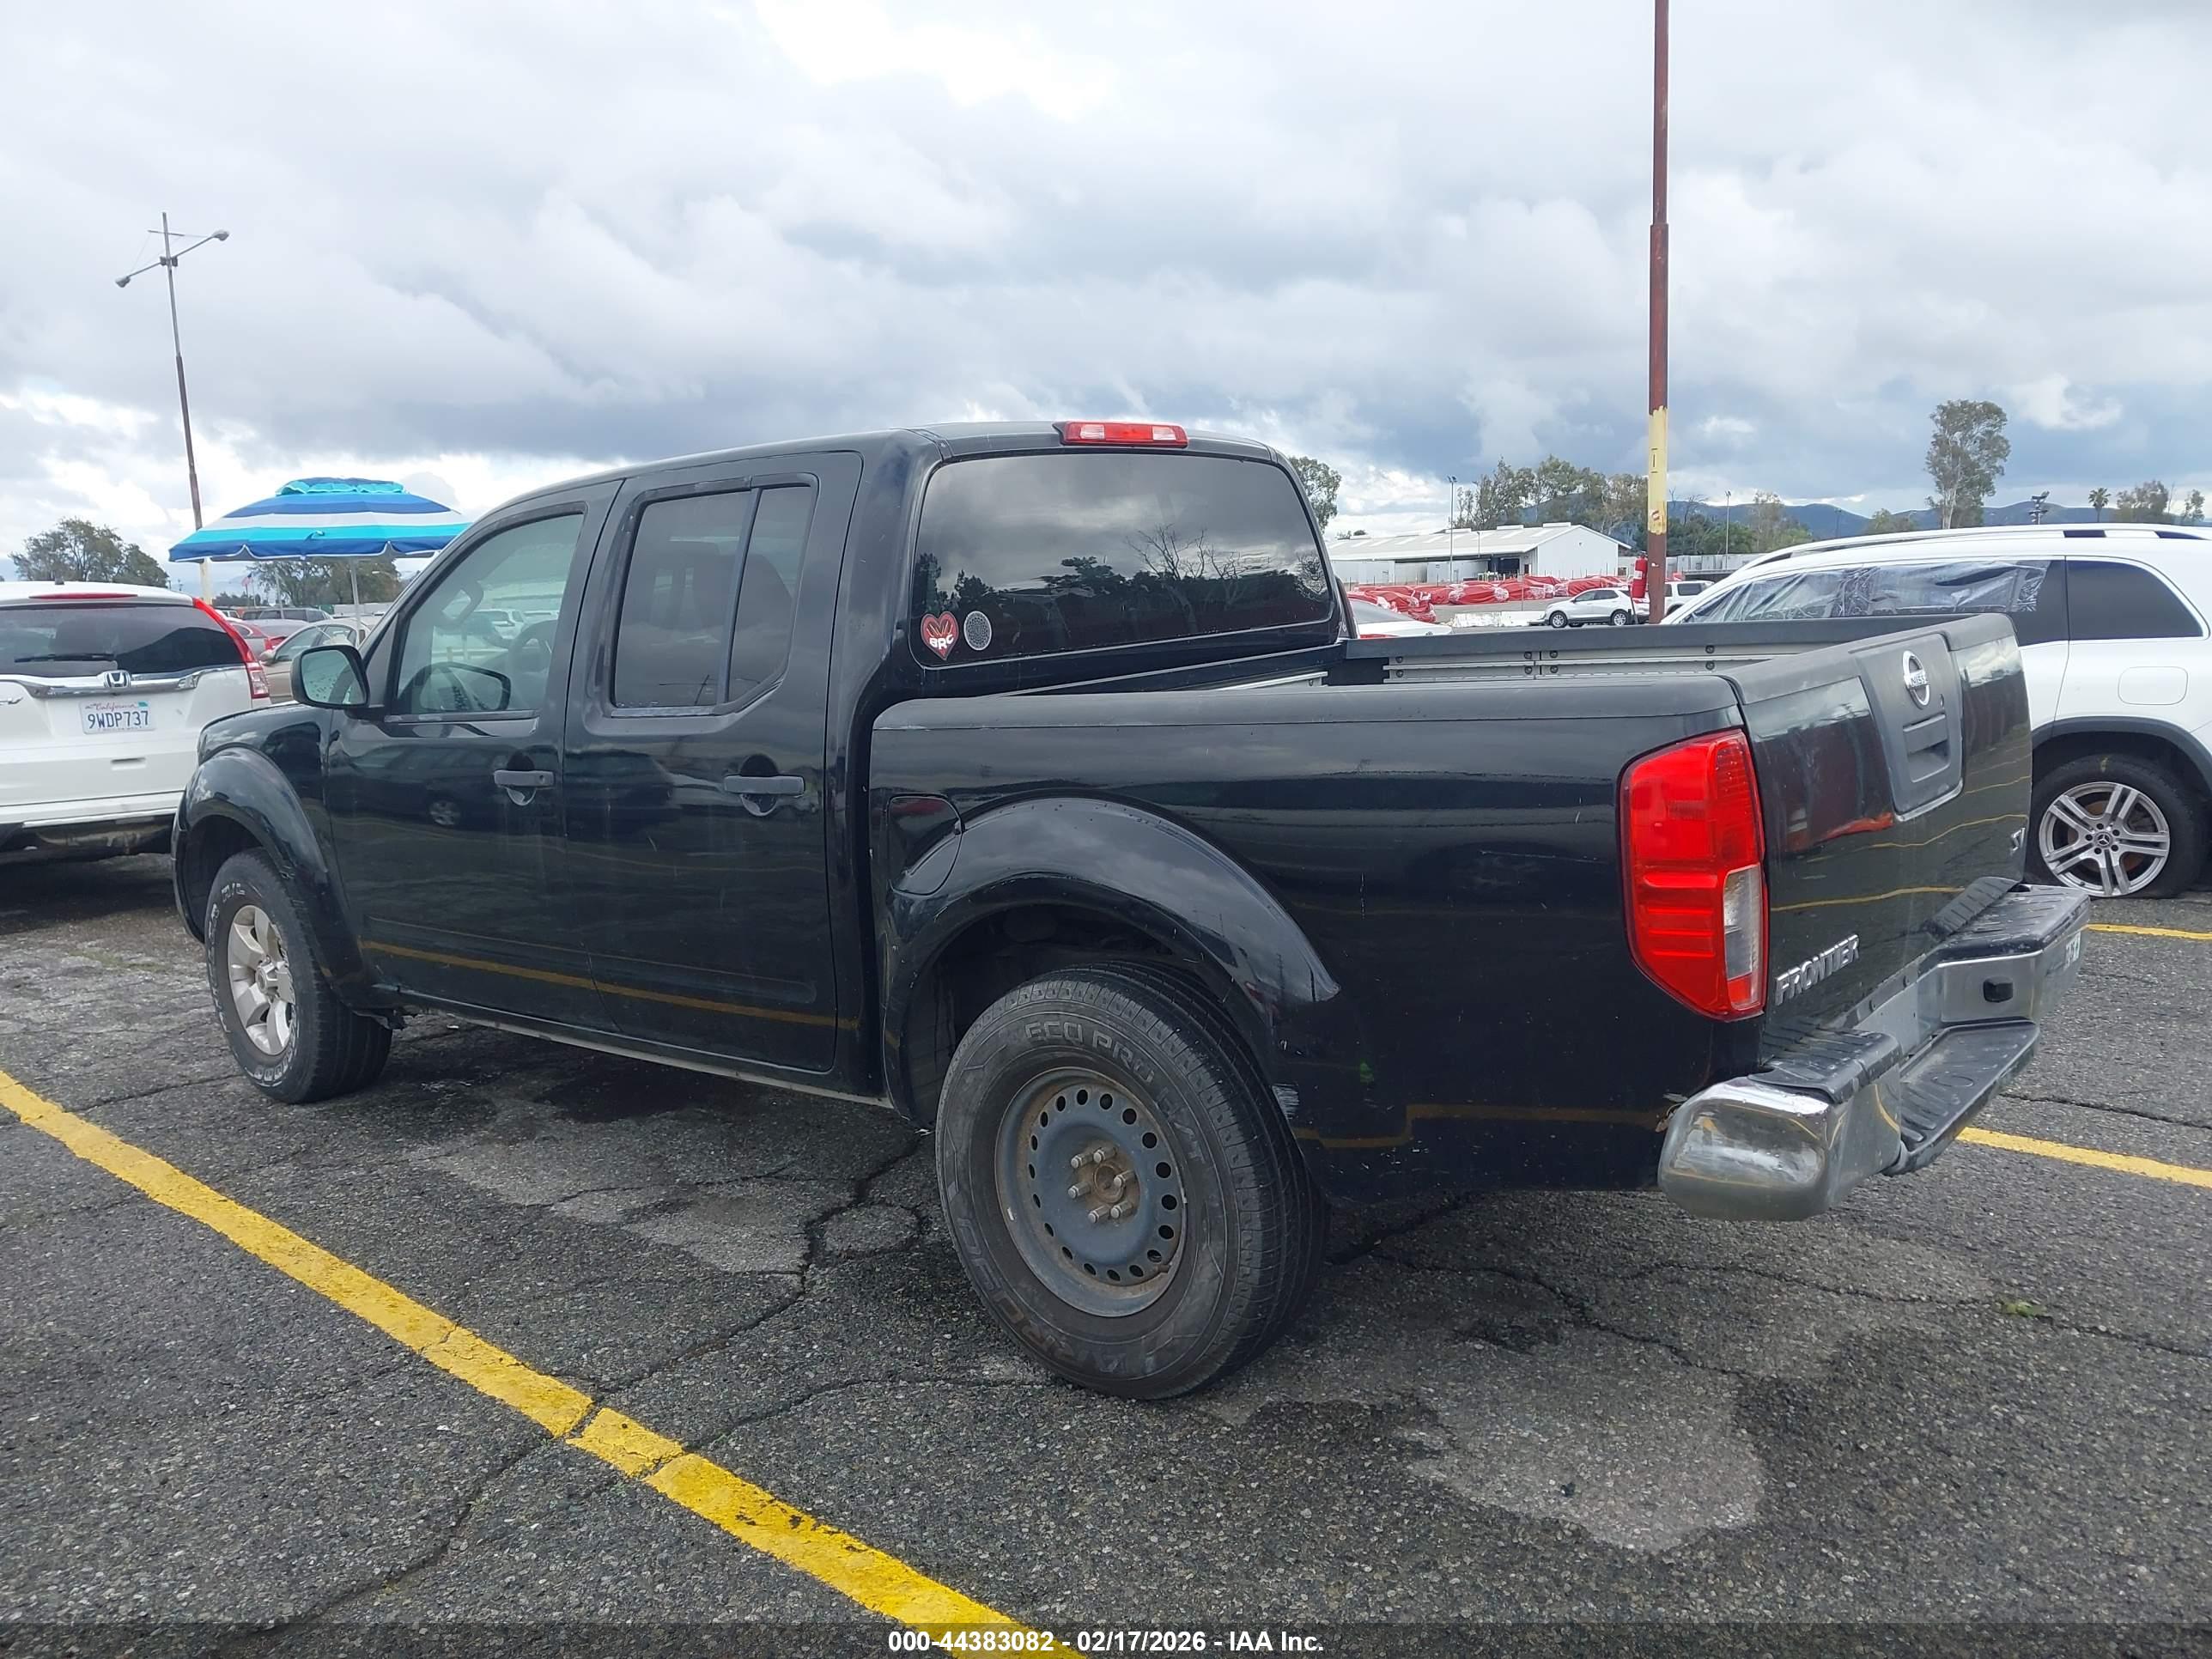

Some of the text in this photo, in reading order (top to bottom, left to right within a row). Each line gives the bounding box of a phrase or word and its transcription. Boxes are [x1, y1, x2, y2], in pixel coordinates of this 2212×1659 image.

[929, 634, 954, 650] BRC
[88, 710, 149, 729] 9WDP737
[1774, 934, 1859, 1006] FRONTIER
[1025, 1021, 1084, 1044] ECO
[1092, 1030, 1155, 1084] PRO
